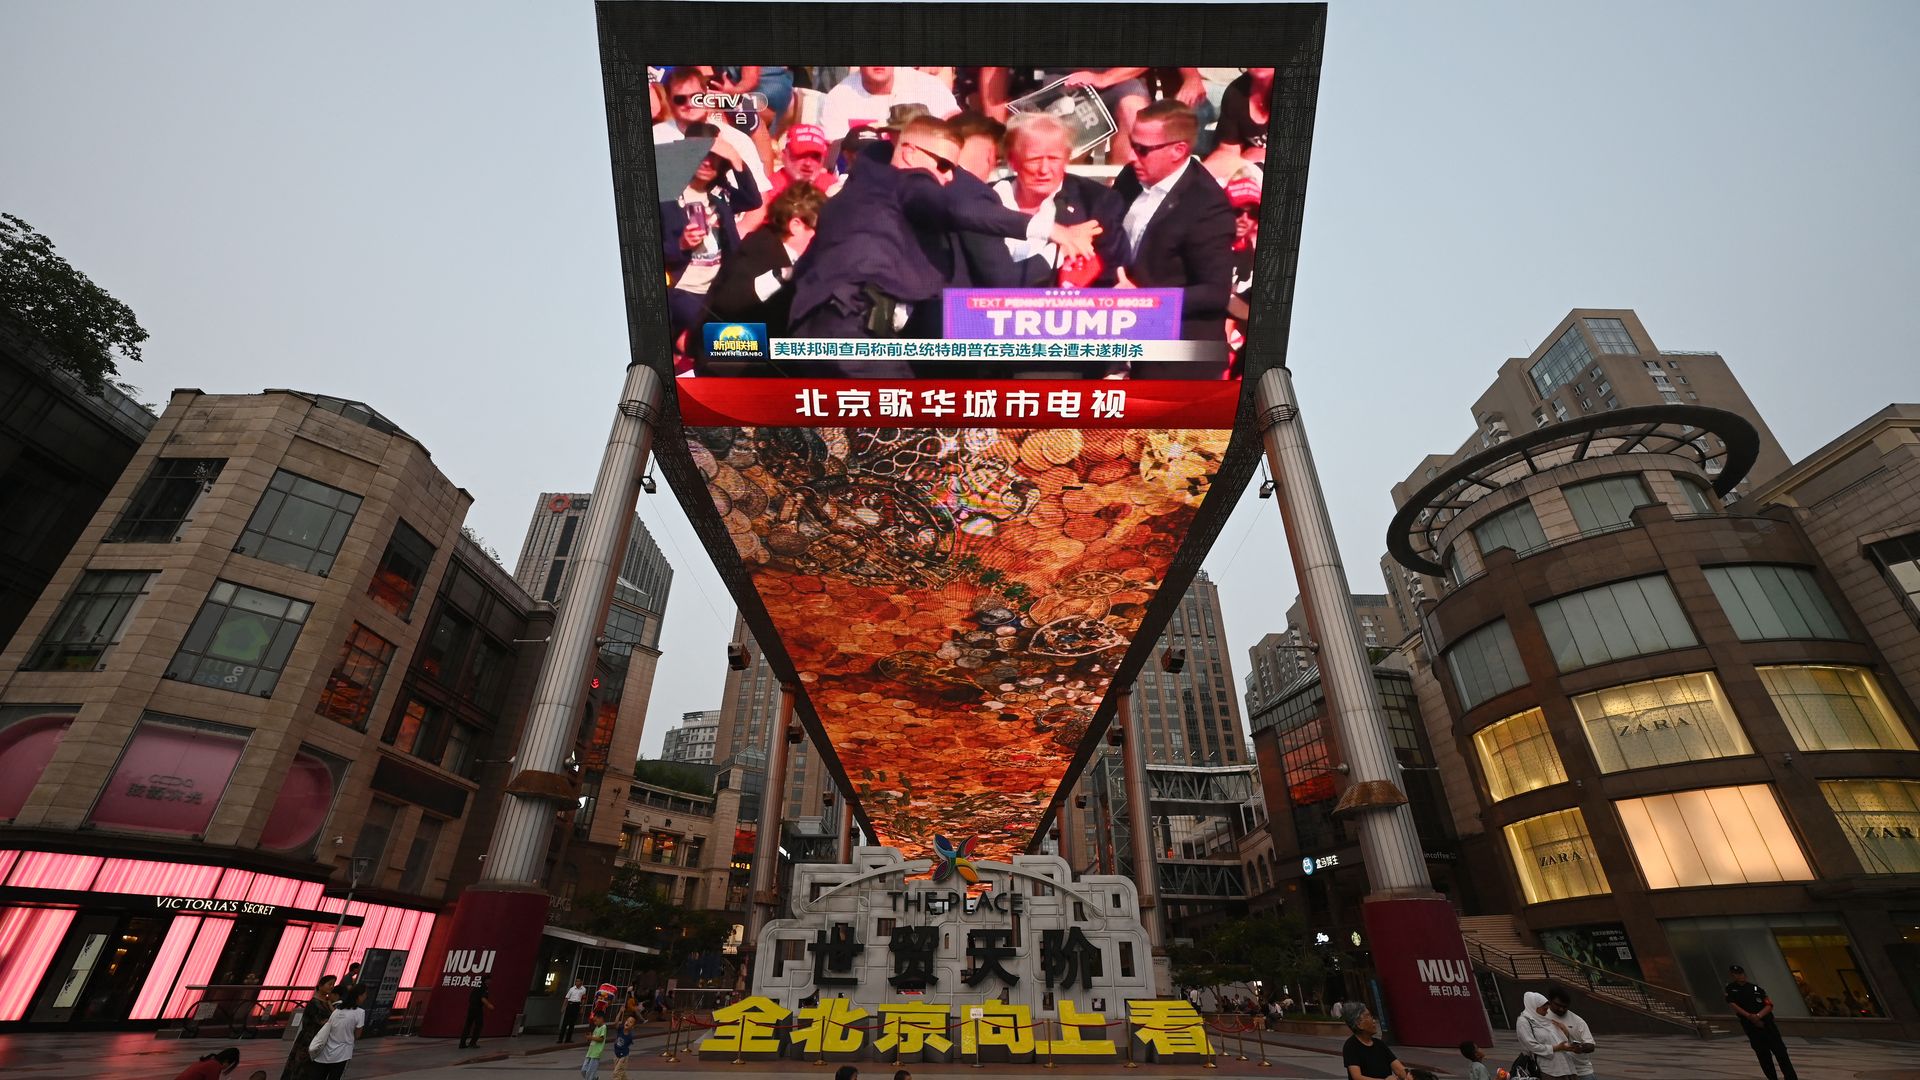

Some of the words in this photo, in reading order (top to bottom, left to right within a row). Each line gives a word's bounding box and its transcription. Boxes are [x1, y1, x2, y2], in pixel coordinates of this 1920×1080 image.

[691, 93, 741, 108] CCTV
[972, 298, 1001, 308] TEXT
[1098, 298, 1115, 308] TO
[986, 310, 1137, 336] TRUMP
[713, 340, 758, 351] 新闻联播
[774, 341, 1144, 358] 美联邦调查局称前总统特朗普在竞选集会遭未遂刺杀
[794, 388, 1127, 418] 北京歌华城市电视
[1617, 717, 1693, 737] ZARA
[1860, 826, 1920, 839] ZAR
[1540, 851, 1583, 867] ZARA
[156, 896, 239, 912] VICTORIA'S
[241, 901, 276, 916] SECRET
[887, 891, 938, 913] THE
[946, 891, 1023, 914] PLACE
[443, 949, 497, 974] MUJI
[807, 925, 1102, 989] 世贸天阶
[442, 974, 483, 988] 無印良品
[1416, 959, 1470, 984] MUJI
[1428, 985, 1471, 997] 無印良品
[700, 995, 1216, 1055] 全北京向上看
